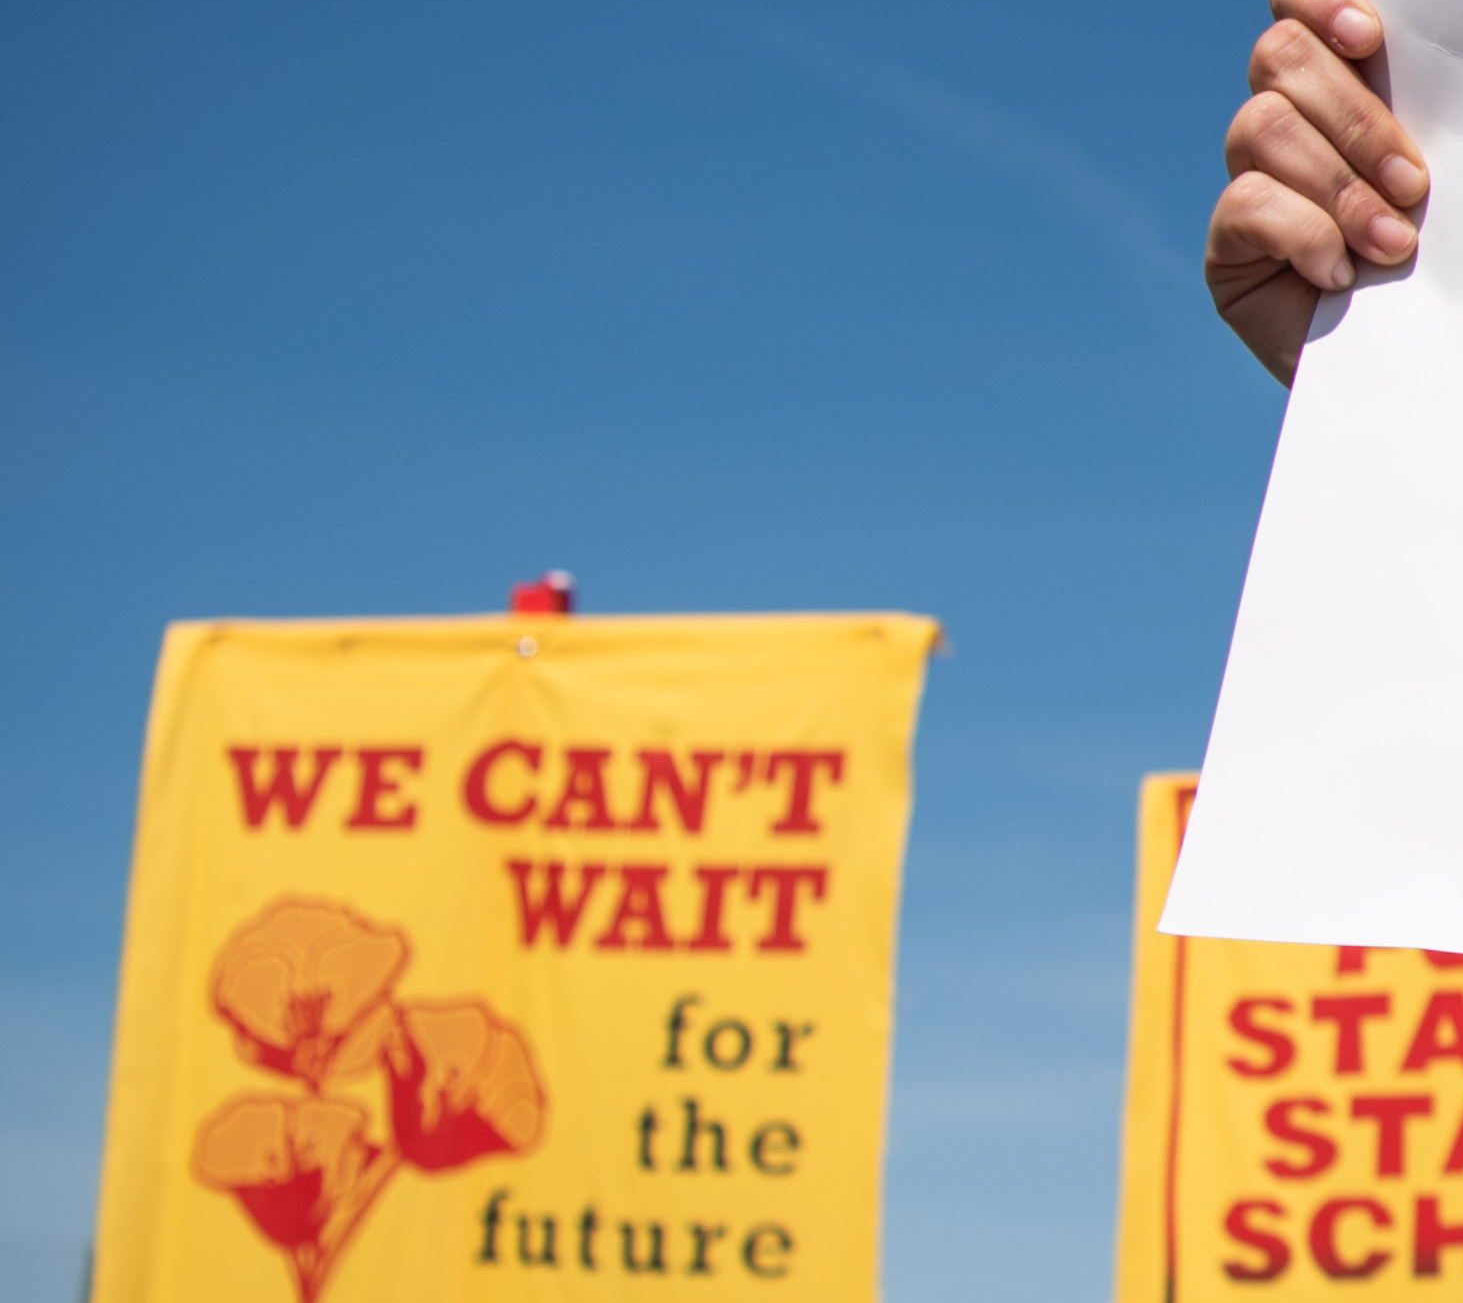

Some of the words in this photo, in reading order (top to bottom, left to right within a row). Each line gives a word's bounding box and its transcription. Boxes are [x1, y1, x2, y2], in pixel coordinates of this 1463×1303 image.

[229, 747, 423, 830] WE
[460, 739, 846, 836] CAN'T
[505, 858, 829, 953] WAIT
[664, 996, 814, 1073] for
[637, 1100, 802, 1176] the
[475, 1192, 795, 1276] future
